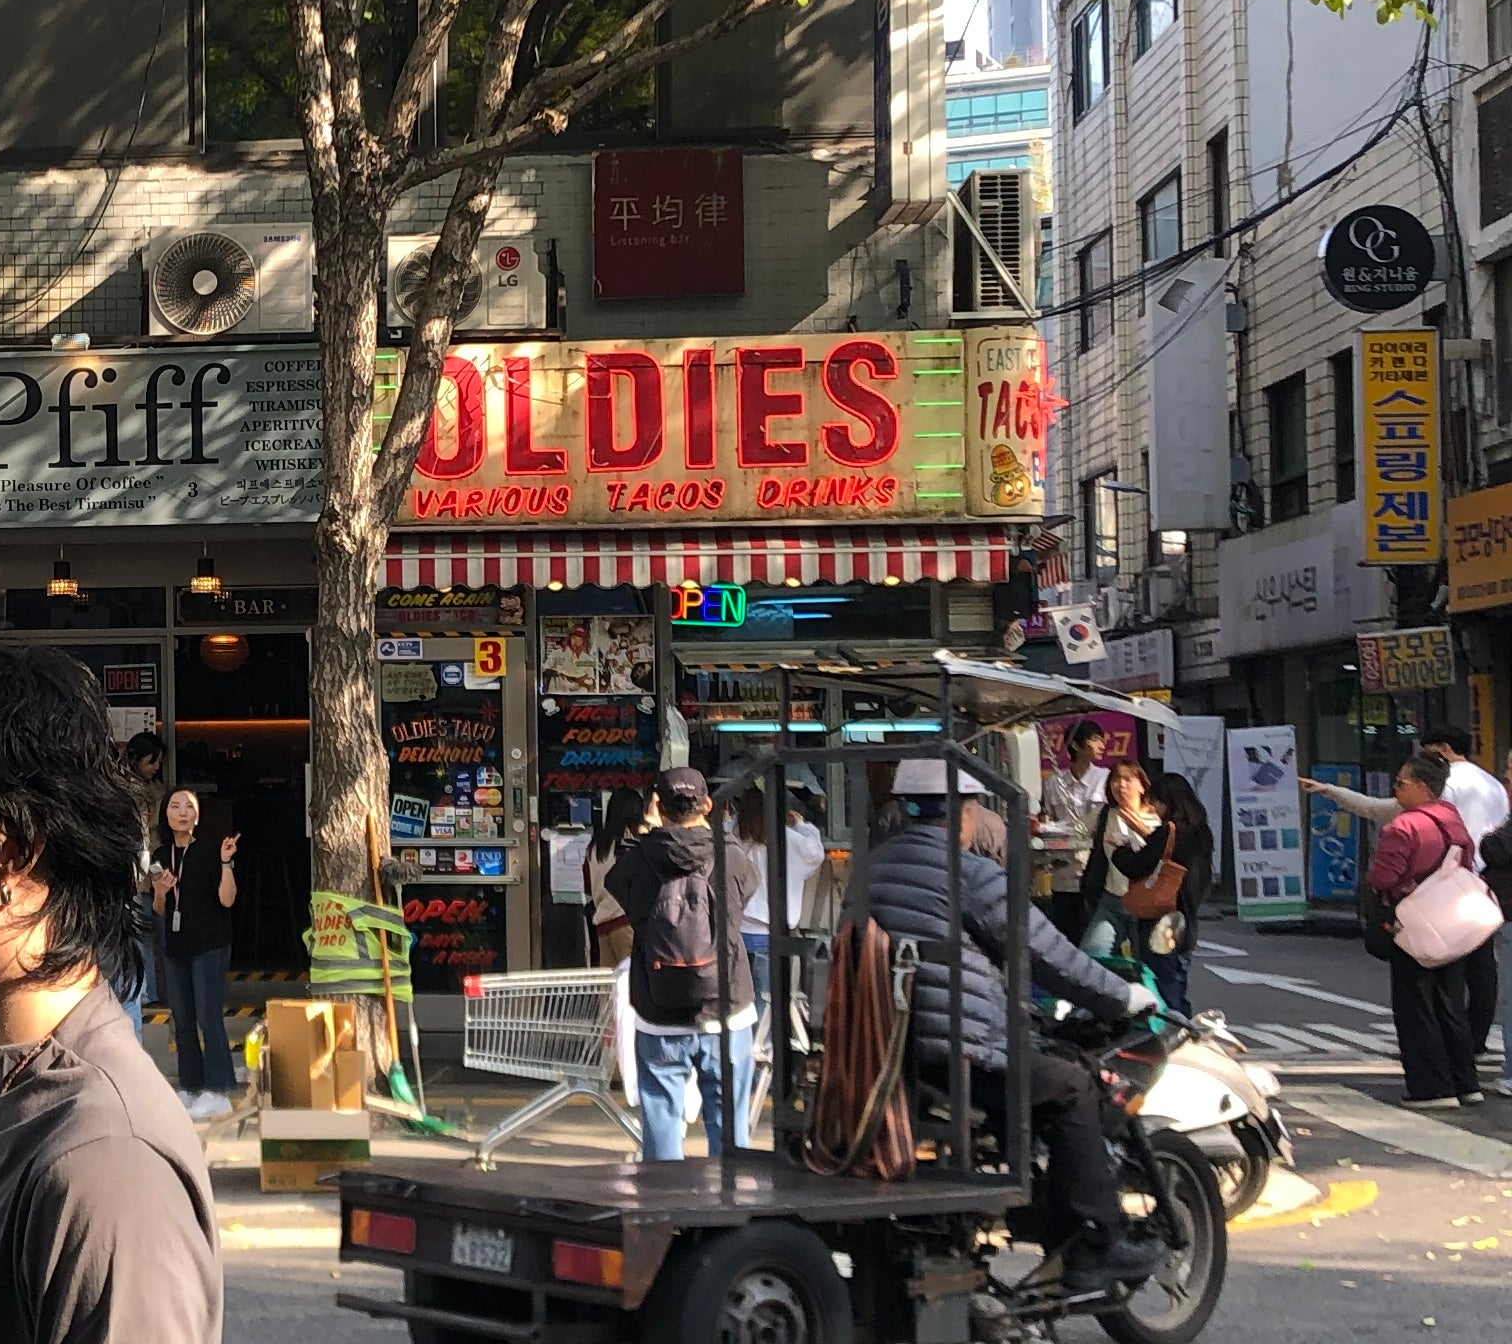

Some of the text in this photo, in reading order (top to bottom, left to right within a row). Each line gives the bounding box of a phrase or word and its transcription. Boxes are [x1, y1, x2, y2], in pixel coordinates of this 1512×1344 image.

[609, 194, 727, 231] 平均律
[610, 235, 666, 248] Listening
[498, 274, 519, 288] LG
[987, 348, 1022, 372] EAST
[414, 340, 900, 479] OLDIES
[1373, 389, 1431, 552] 스프링제본
[1, 479, 72, 492] Pleasure
[76, 477, 98, 490] Of
[100, 476, 152, 490] Coffee
[187, 481, 199, 498] 3
[4, 499, 35, 513] The
[38, 497, 72, 511] Best
[75, 495, 145, 510] Tiramisu
[414, 476, 897, 518] VARIOUS TACOS DRINKS
[234, 600, 276, 615] BAR
[388, 590, 496, 607] COME AGAIN
[398, 609, 441, 623] OLDIES
[479, 641, 502, 674] 3
[108, 669, 139, 691] OPEN
[392, 718, 496, 743] OLDIES TACO
[561, 728, 637, 744] FOODS
[393, 797, 427, 819] OPEN
[434, 826, 452, 835] VISA
[403, 898, 489, 924] OPEN
[318, 933, 346, 948] TACO
